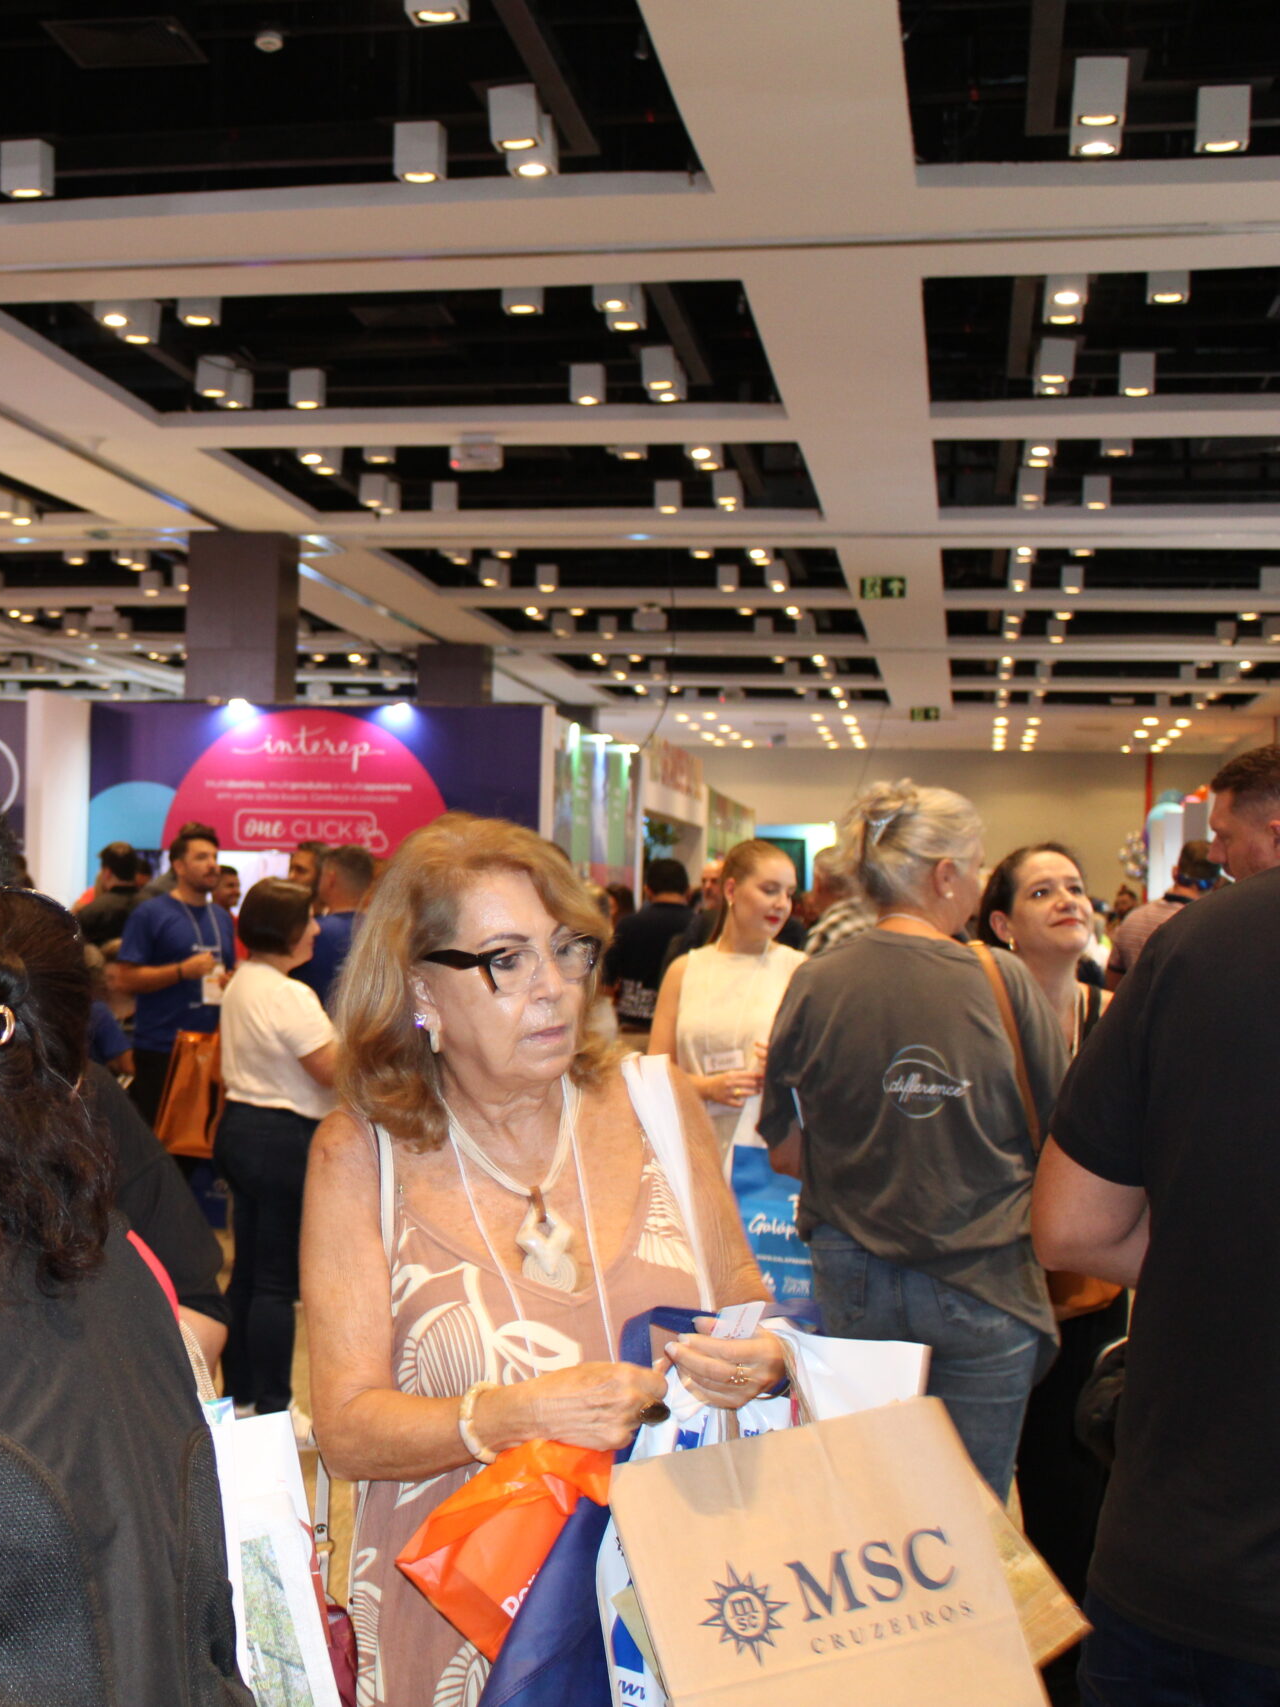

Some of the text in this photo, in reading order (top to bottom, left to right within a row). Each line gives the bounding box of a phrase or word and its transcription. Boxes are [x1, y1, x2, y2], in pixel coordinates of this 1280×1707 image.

[232, 725, 386, 772] interep
[243, 817, 353, 840] one CLICK
[784, 1525, 956, 1622] MSC
[810, 1600, 975, 1654] CRUZEIROS
